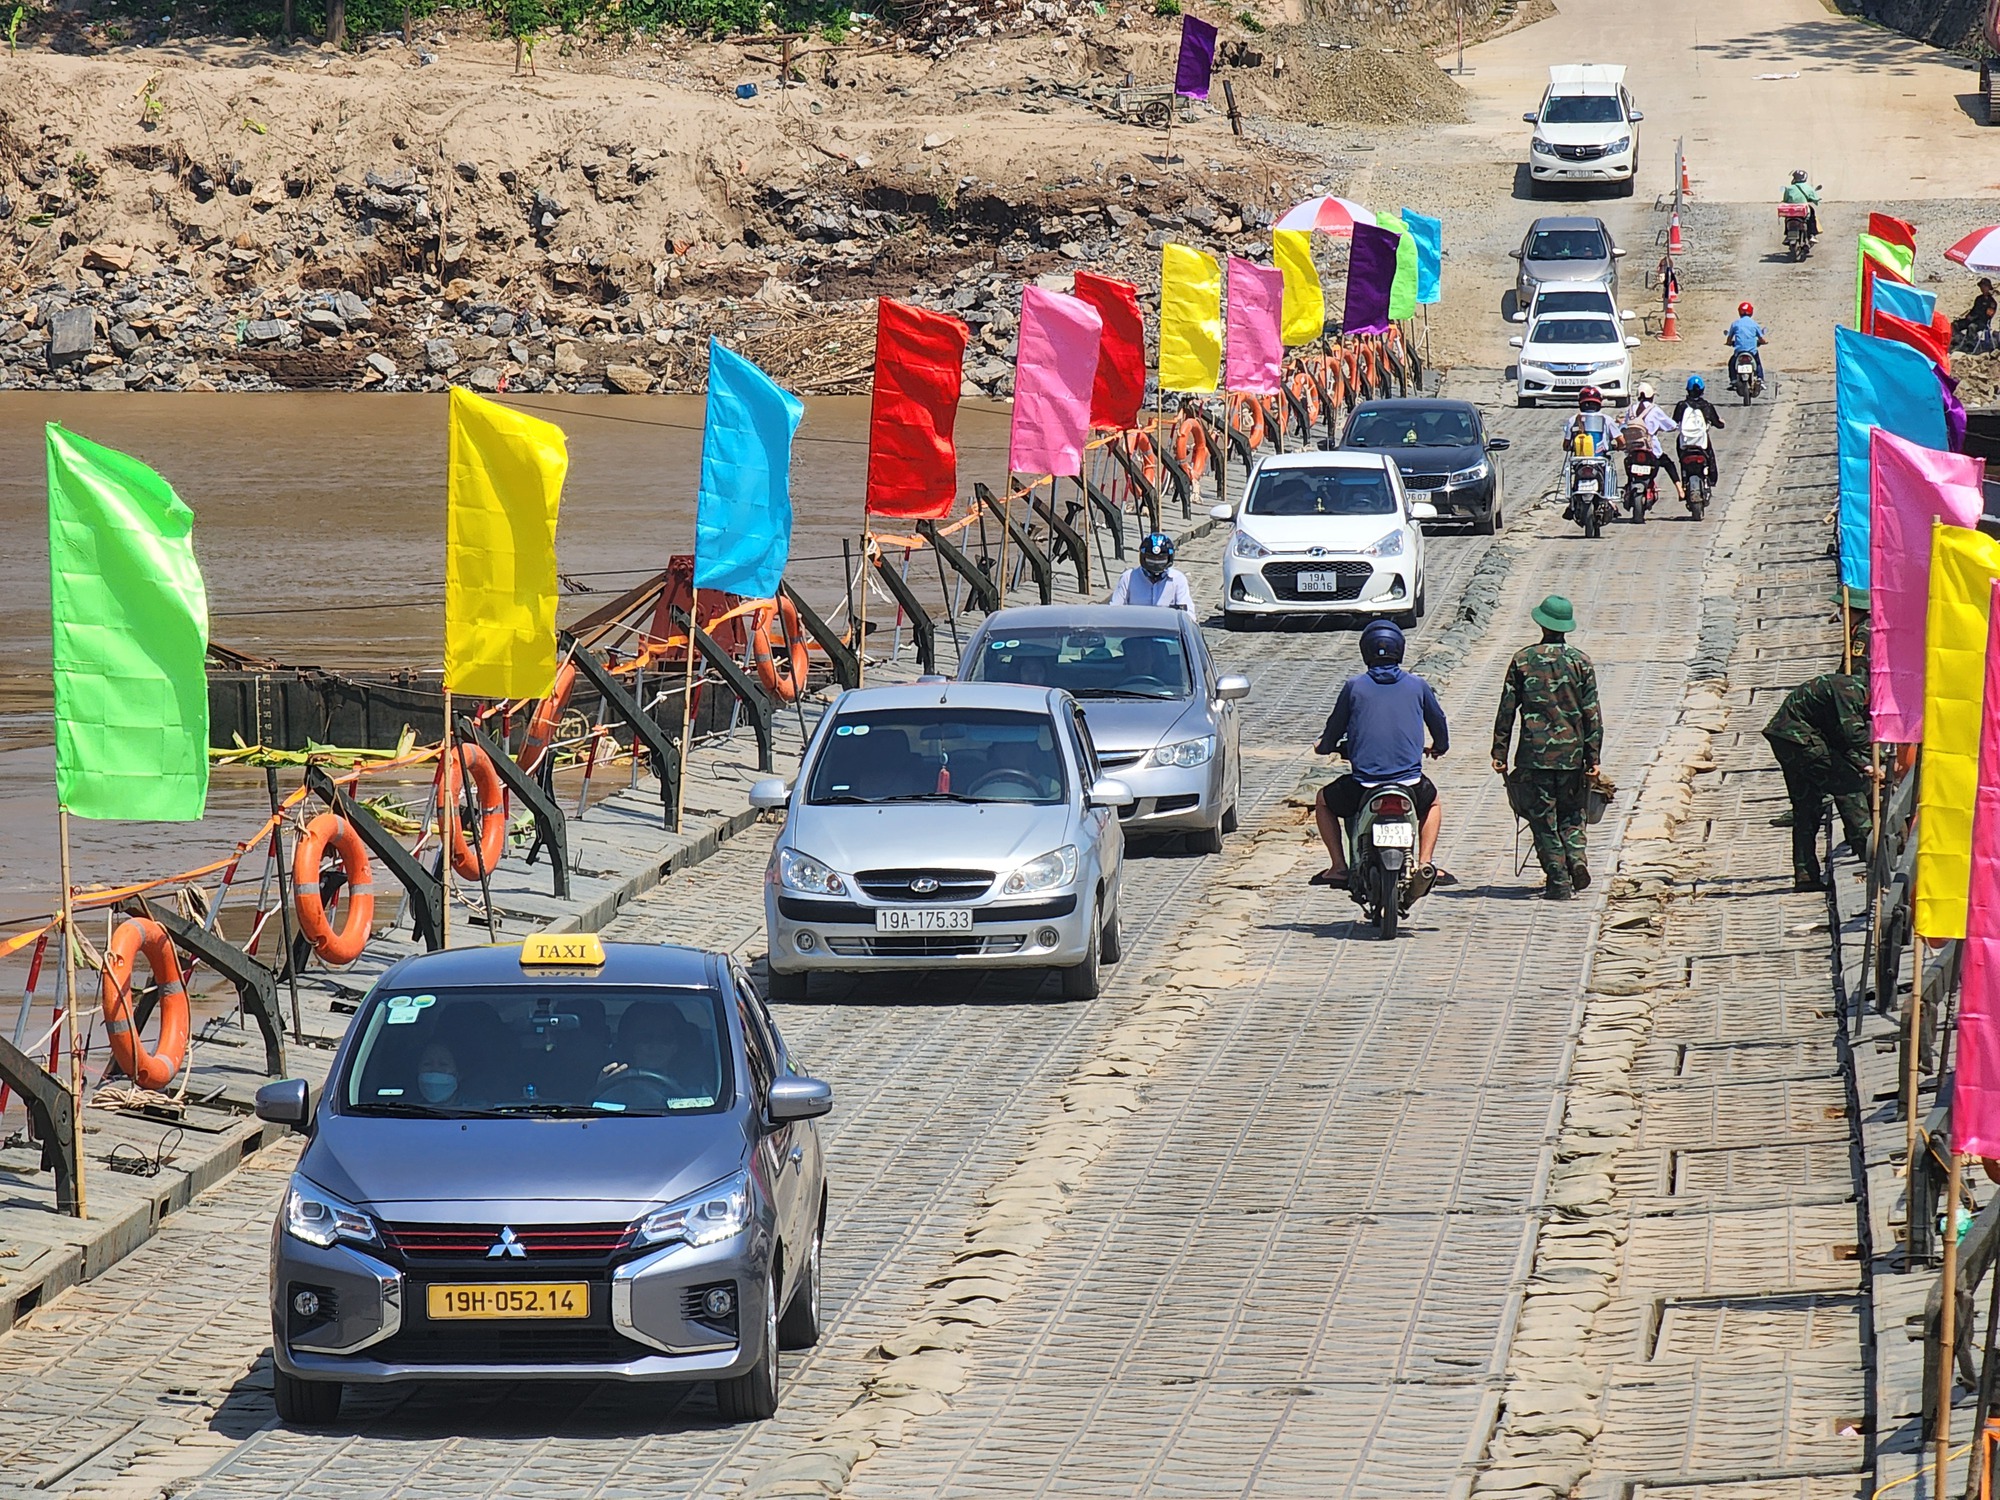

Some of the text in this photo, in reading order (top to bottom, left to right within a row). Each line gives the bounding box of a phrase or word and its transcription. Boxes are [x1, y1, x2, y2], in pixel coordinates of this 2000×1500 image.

[1309, 573, 1326, 582] 19A
[1302, 582, 1333, 591] 380.16
[1380, 825, 1405, 835] 19-S1
[881, 911, 969, 929] 19A-175.33
[536, 945, 587, 958] TAXI
[445, 1290, 574, 1312] 19H-052.14
